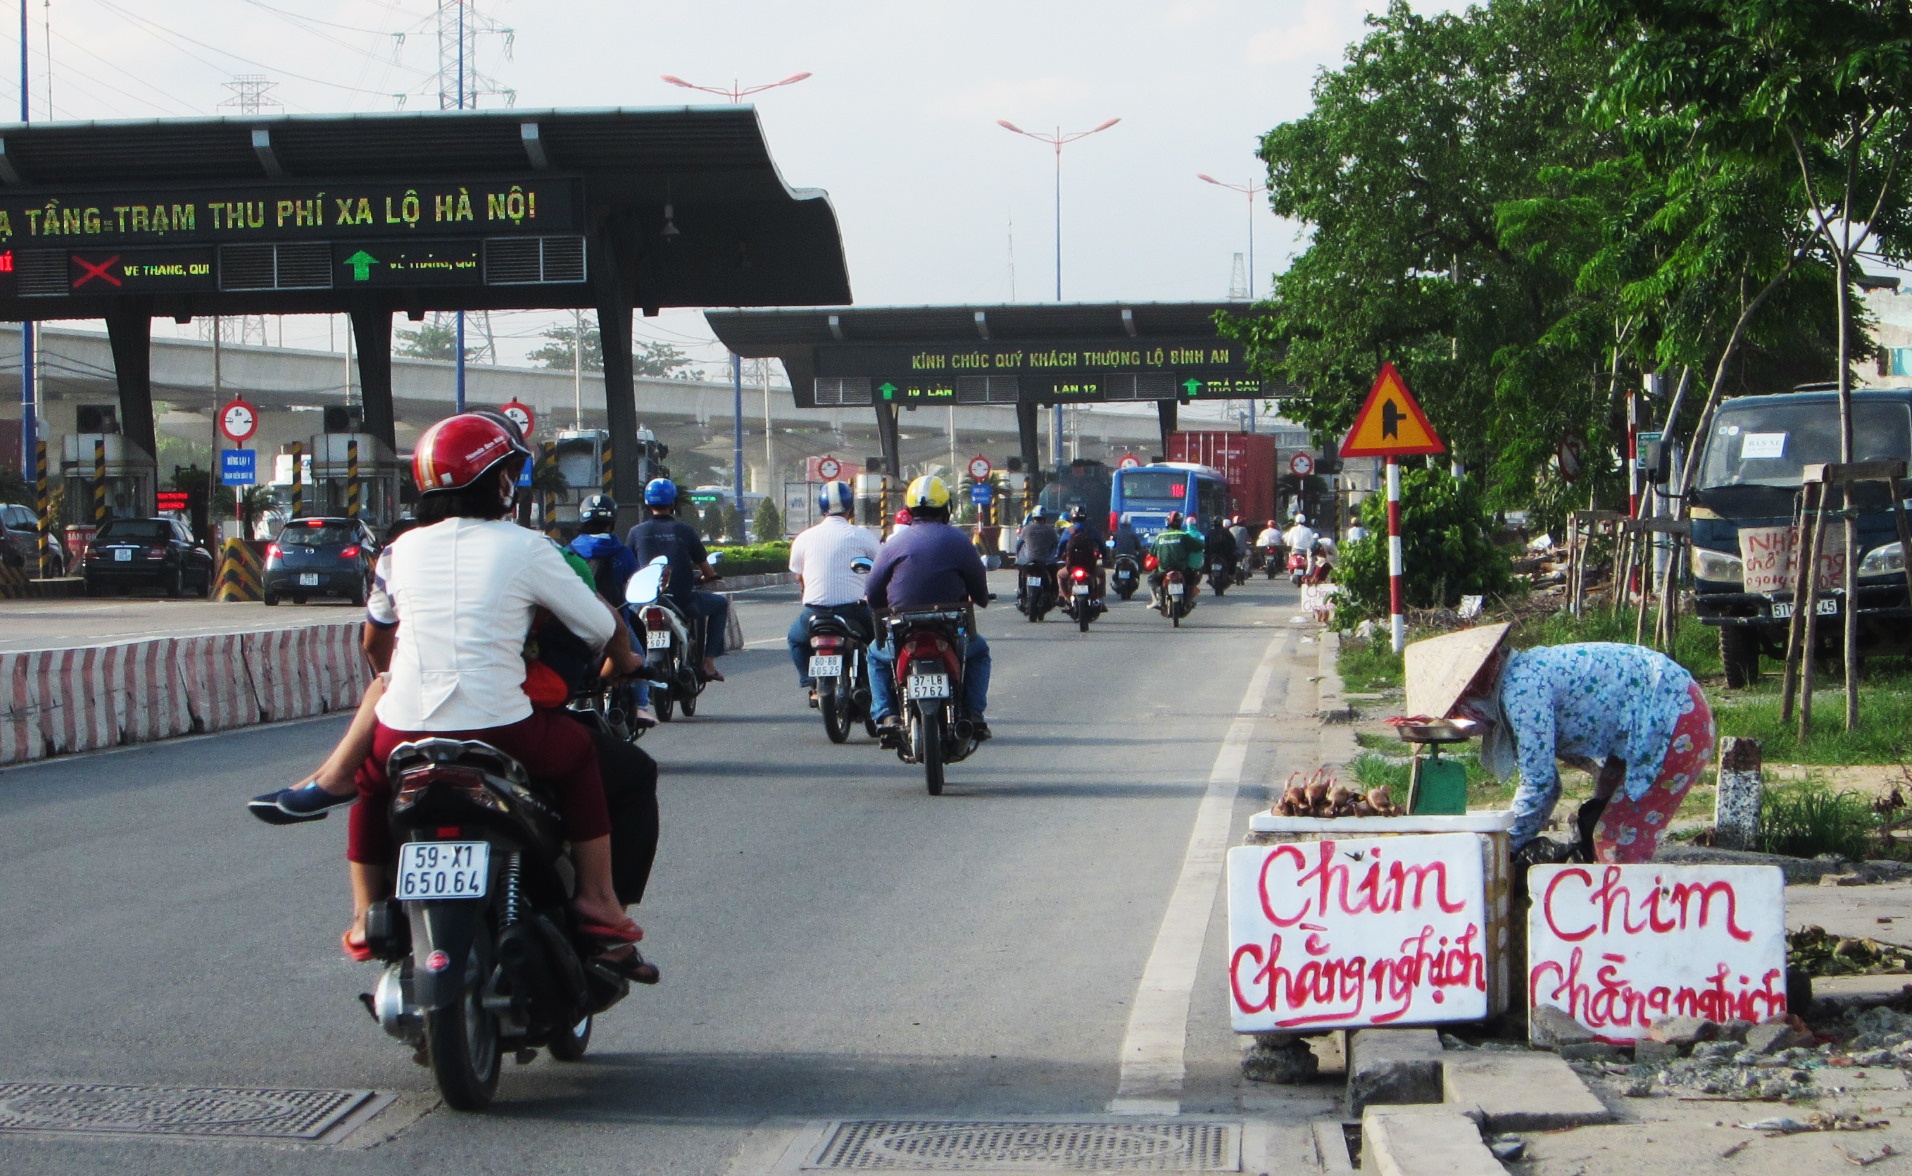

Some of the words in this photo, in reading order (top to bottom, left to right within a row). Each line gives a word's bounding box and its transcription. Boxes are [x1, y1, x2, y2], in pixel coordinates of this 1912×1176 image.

[208, 201, 265, 229] THU
[277, 191, 326, 227] PHÍ
[336, 197, 374, 226] XA
[386, 188, 420, 228] LỘ
[435, 187, 474, 222] HÀ
[912, 352, 946, 370] KÍNH
[952, 350, 990, 369] CHÚC
[995, 350, 1023, 367] QUÝ
[1029, 350, 1078, 367] KHÁCH
[1083, 350, 1141, 368] THƯỢNG
[1146, 347, 1164, 368] LỘ
[1210, 349, 1230, 364] AN
[914, 686, 944, 698] 5762
[415, 845, 473, 869] 59-X1
[404, 870, 480, 895] 650.64
[1258, 840, 1467, 928] Chim
[1543, 865, 1754, 942] Chim
